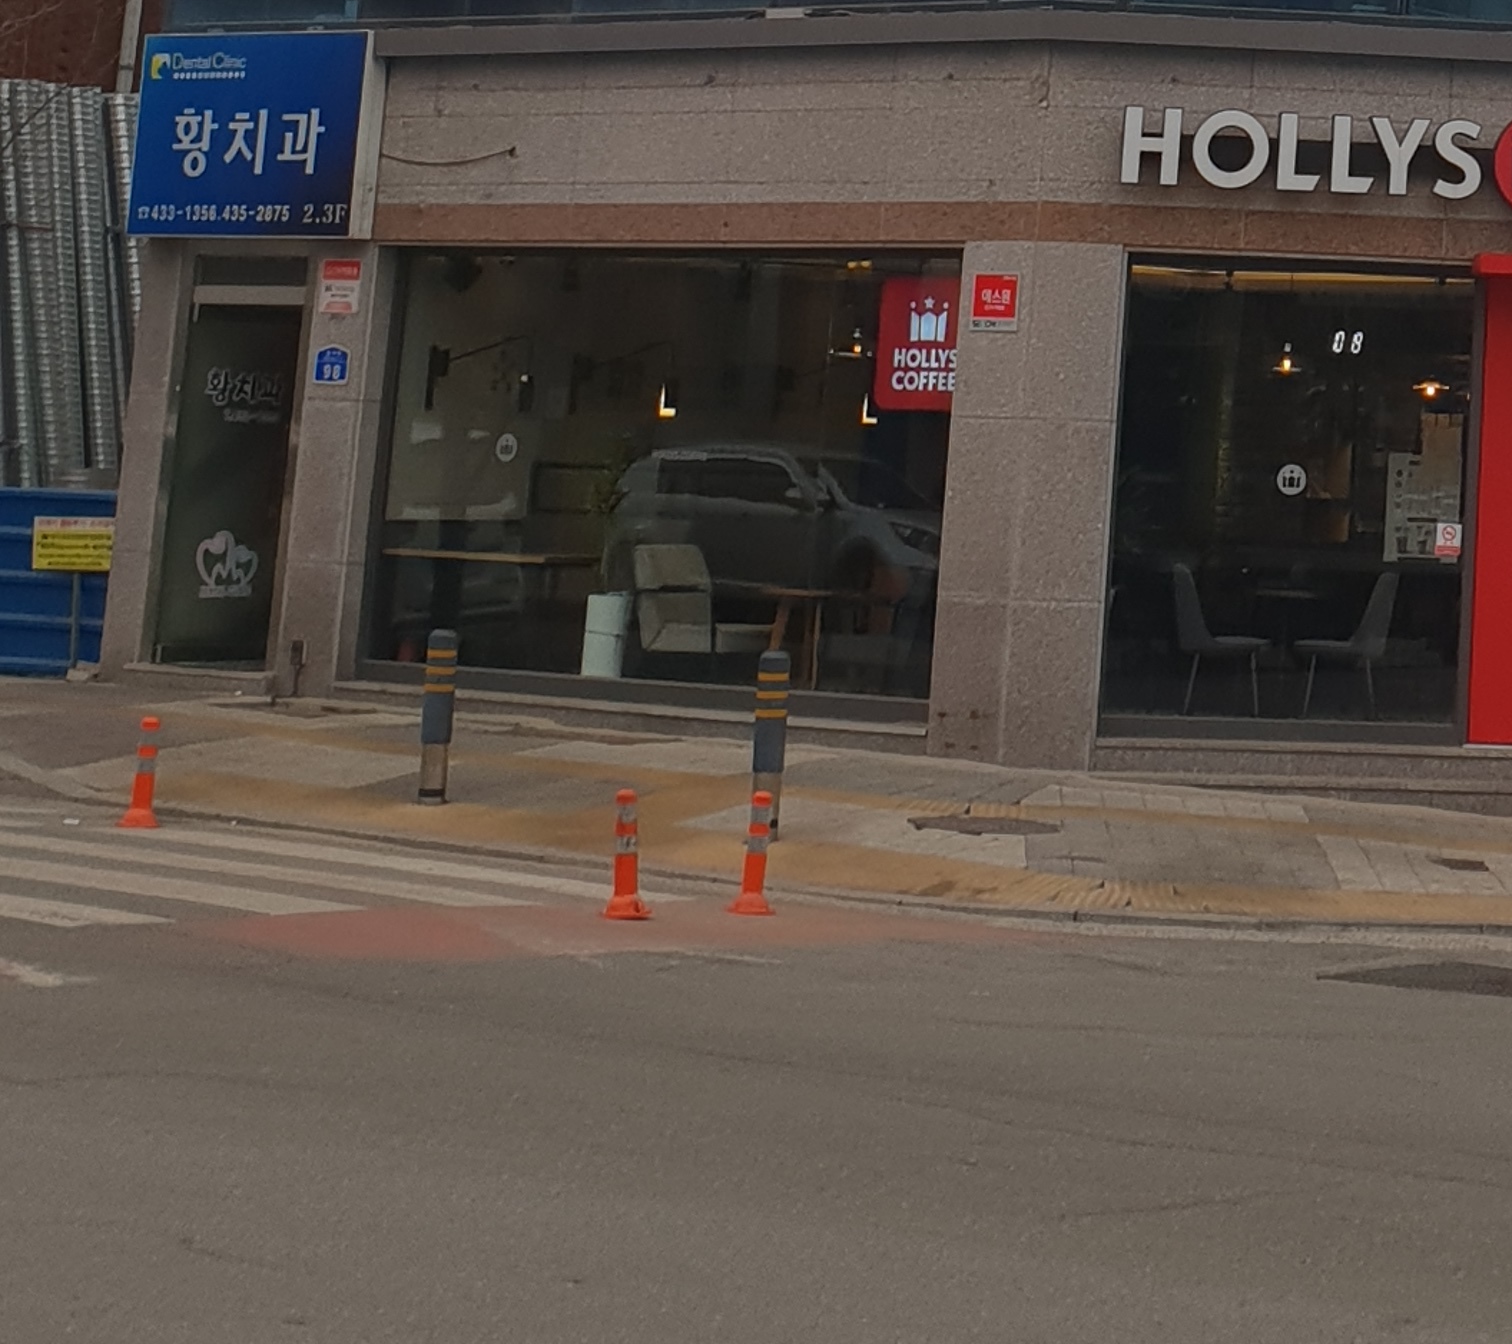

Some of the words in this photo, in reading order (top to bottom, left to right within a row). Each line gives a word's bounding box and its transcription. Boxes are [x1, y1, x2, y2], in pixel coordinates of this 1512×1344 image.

[172, 52, 211, 71] Dental
[172, 108, 326, 178] 황치과
[1120, 106, 1482, 201] HOLLYS
[302, 203, 347, 224] 2.3F
[893, 347, 958, 369] HOLLYS
[891, 370, 956, 392] COFFEE
